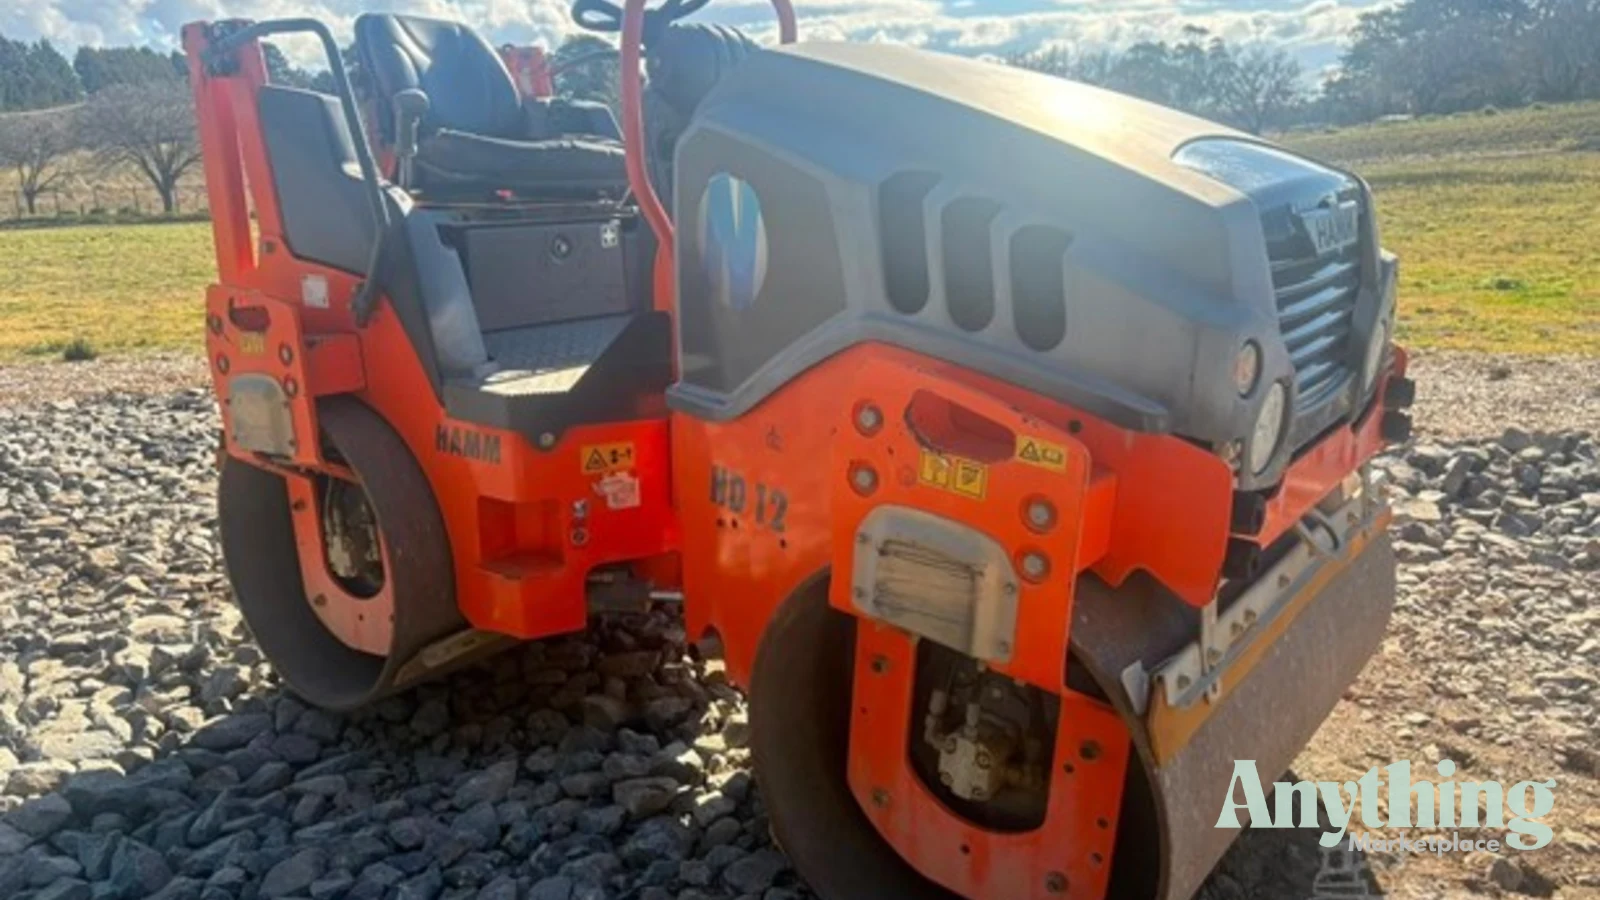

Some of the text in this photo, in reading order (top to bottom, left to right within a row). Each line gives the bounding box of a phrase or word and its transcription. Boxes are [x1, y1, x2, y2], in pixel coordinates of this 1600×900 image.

[436, 423, 501, 465] HAMM
[710, 464, 789, 532] HD 12
